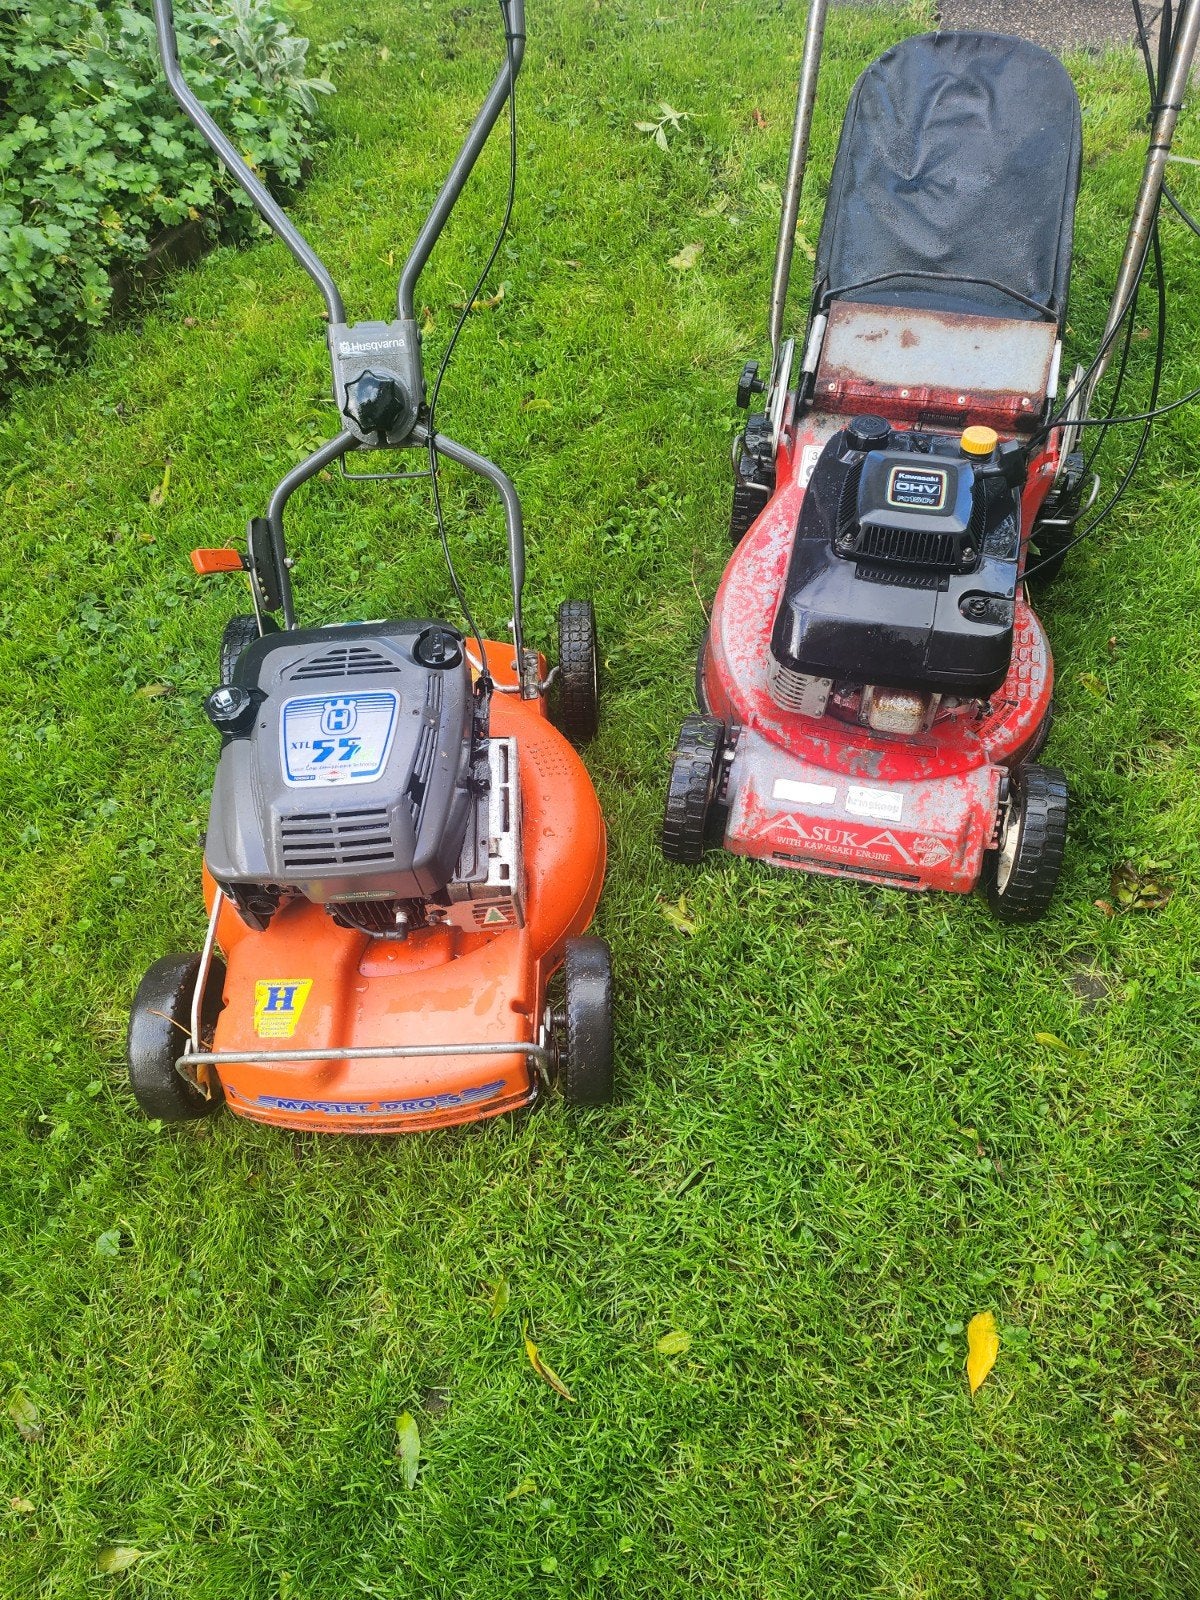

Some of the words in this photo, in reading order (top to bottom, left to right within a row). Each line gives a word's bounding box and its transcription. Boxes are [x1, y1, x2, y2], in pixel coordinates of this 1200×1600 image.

[352, 339, 405, 351] Husqvarna
[896, 482, 938, 493] OHV
[898, 473, 939, 482] Kawasaki
[291, 741, 311, 750] XTL
[312, 737, 361, 763] 55
[751, 814, 919, 866] ASUKA
[777, 837, 801, 847] WITH
[804, 841, 853, 855] KAWASAKI
[855, 850, 892, 862] ENGINE
[263, 986, 298, 1011] H
